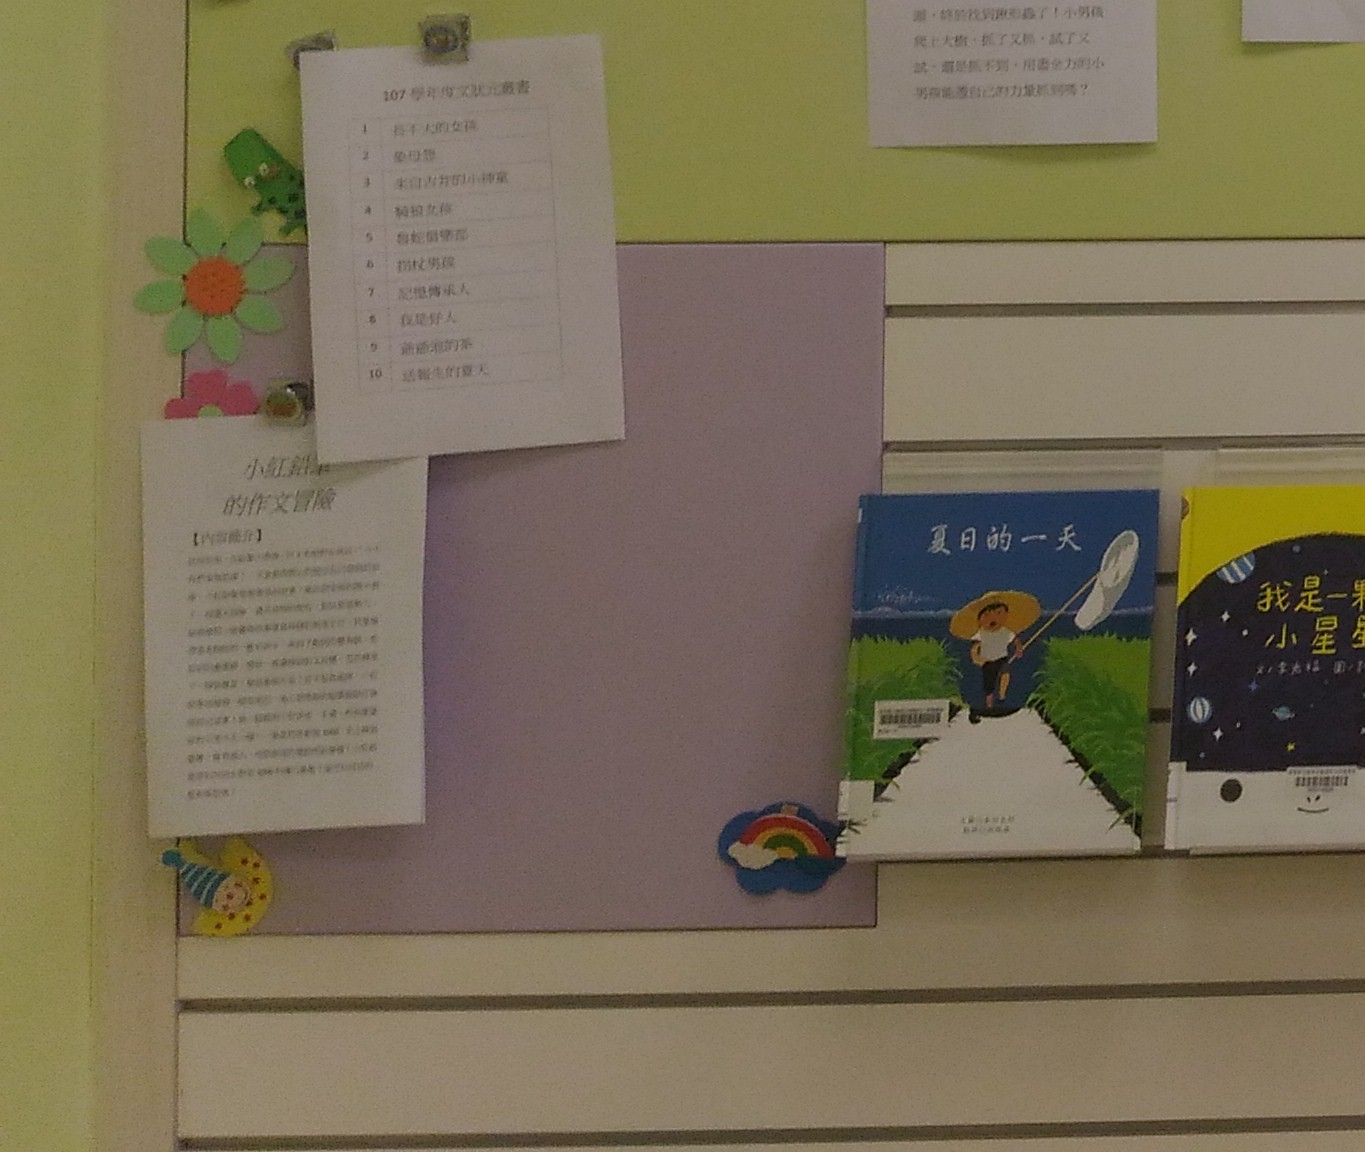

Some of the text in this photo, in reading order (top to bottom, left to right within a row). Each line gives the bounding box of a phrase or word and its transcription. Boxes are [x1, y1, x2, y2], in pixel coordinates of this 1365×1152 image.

[383, 89, 406, 103] 107
[927, 524, 1082, 555] 夏日的一天
